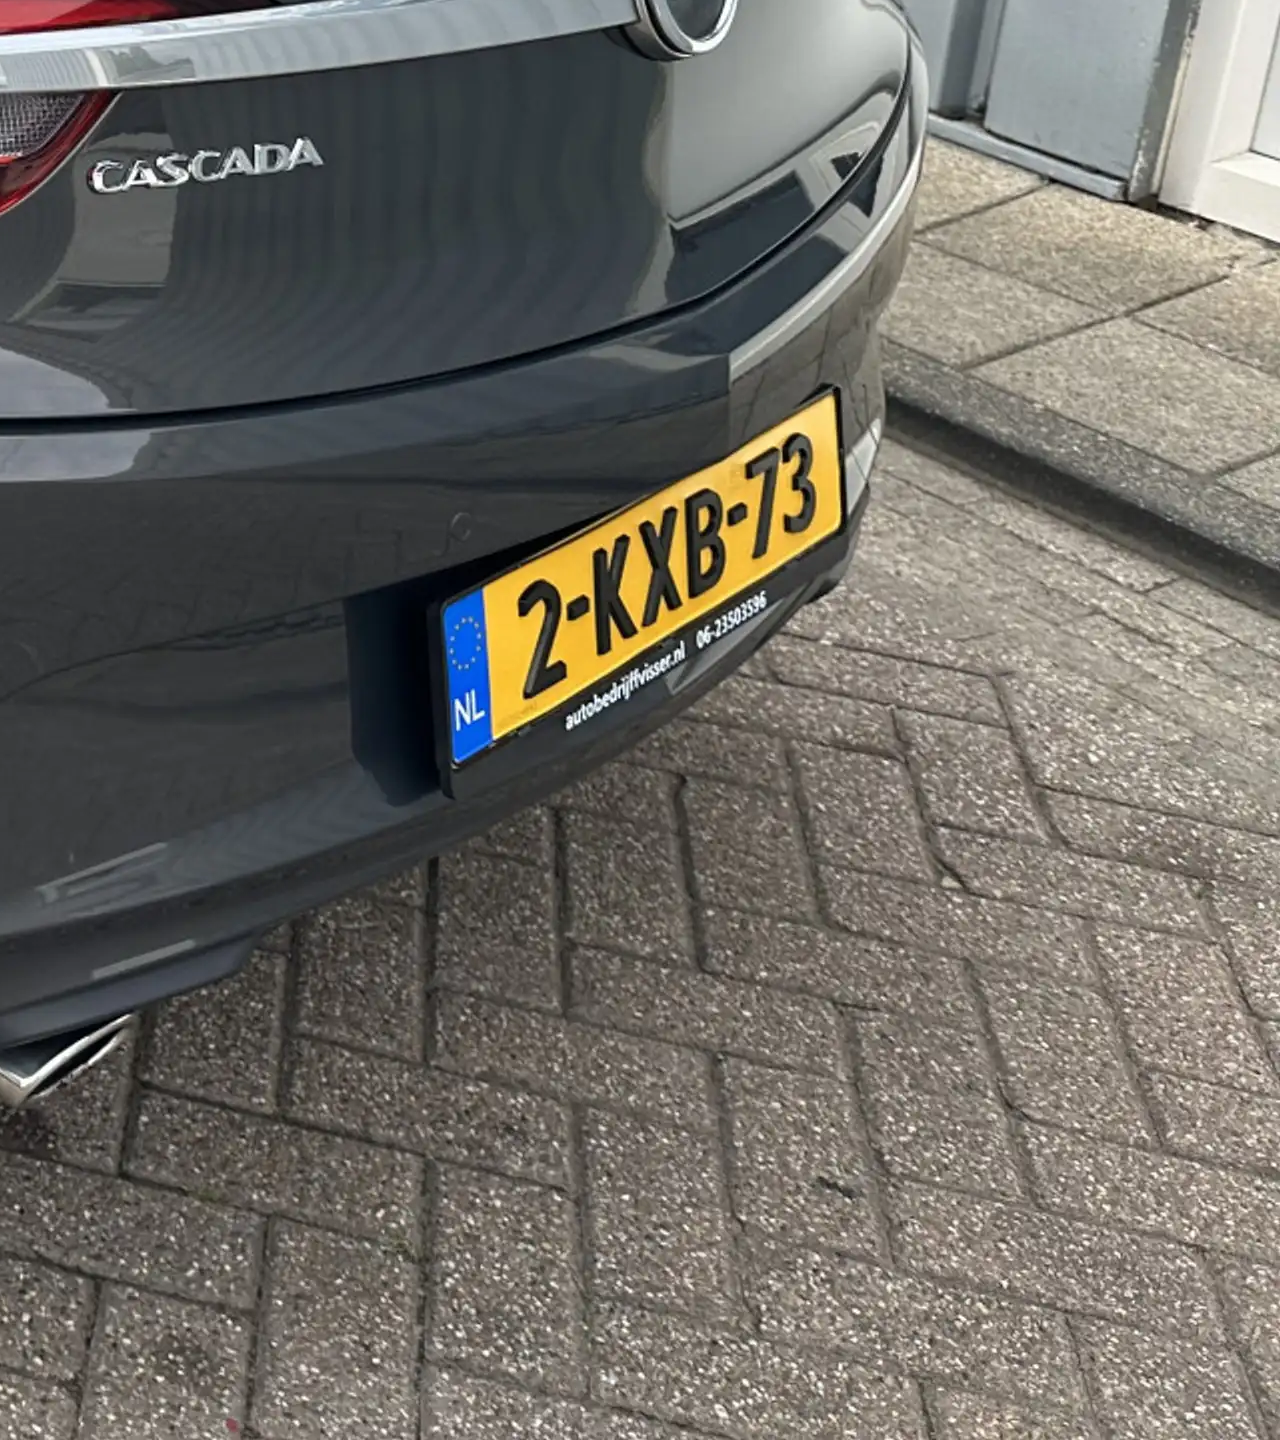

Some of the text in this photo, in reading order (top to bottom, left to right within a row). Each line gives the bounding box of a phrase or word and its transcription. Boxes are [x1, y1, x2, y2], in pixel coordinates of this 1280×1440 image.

[88, 136, 325, 194] CASCADA
[517, 431, 817, 700] 2-KXB-73
[453, 688, 486, 732] NL
